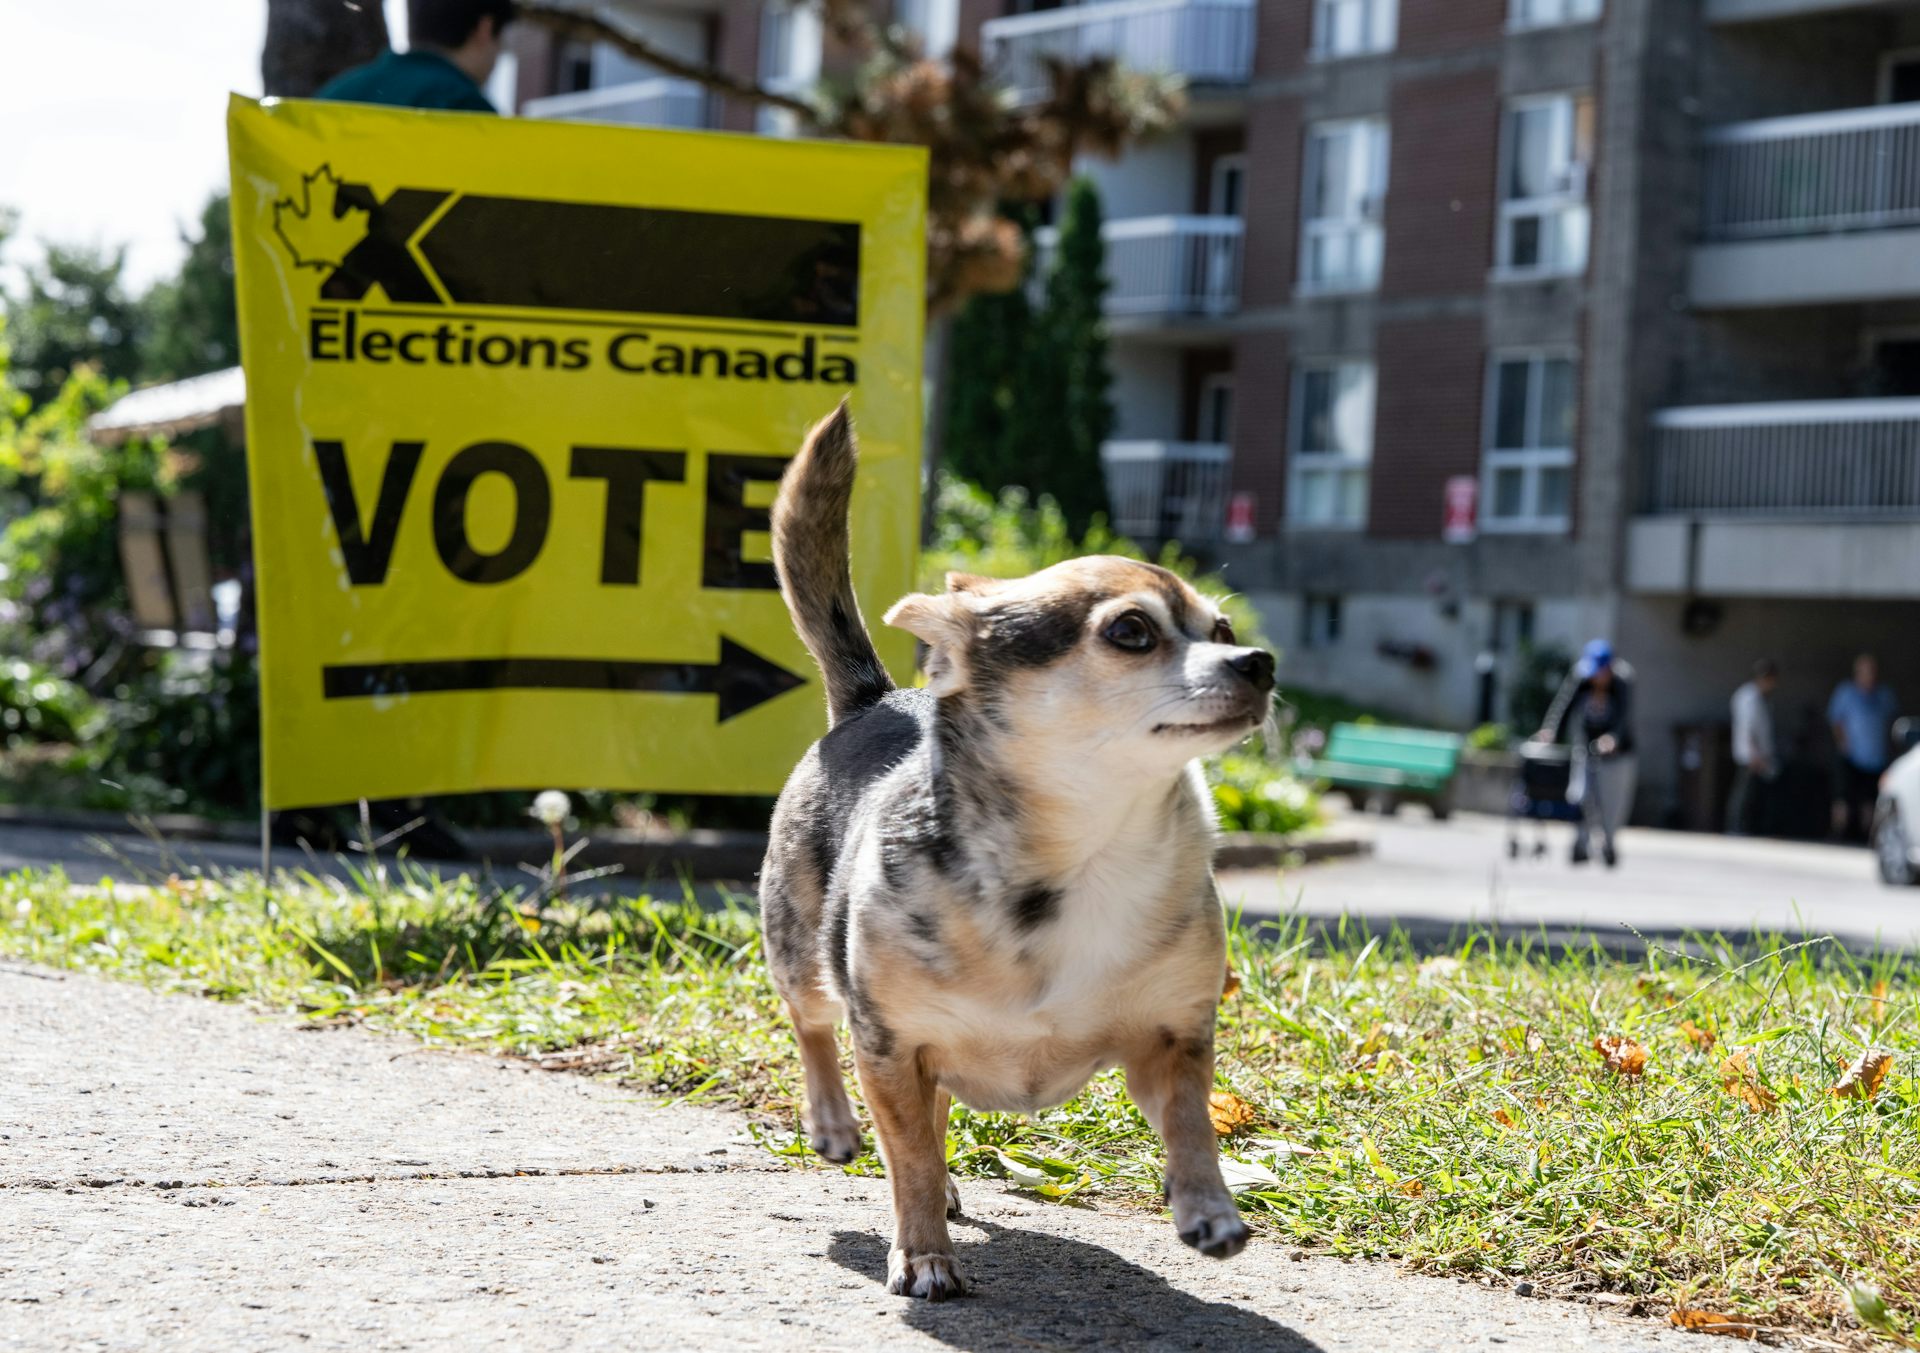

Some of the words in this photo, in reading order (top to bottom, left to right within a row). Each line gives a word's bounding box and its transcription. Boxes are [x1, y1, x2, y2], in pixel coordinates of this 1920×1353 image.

[309, 311, 591, 370] Elections
[607, 332, 858, 385] Canada
[313, 439, 795, 591] VOTE
